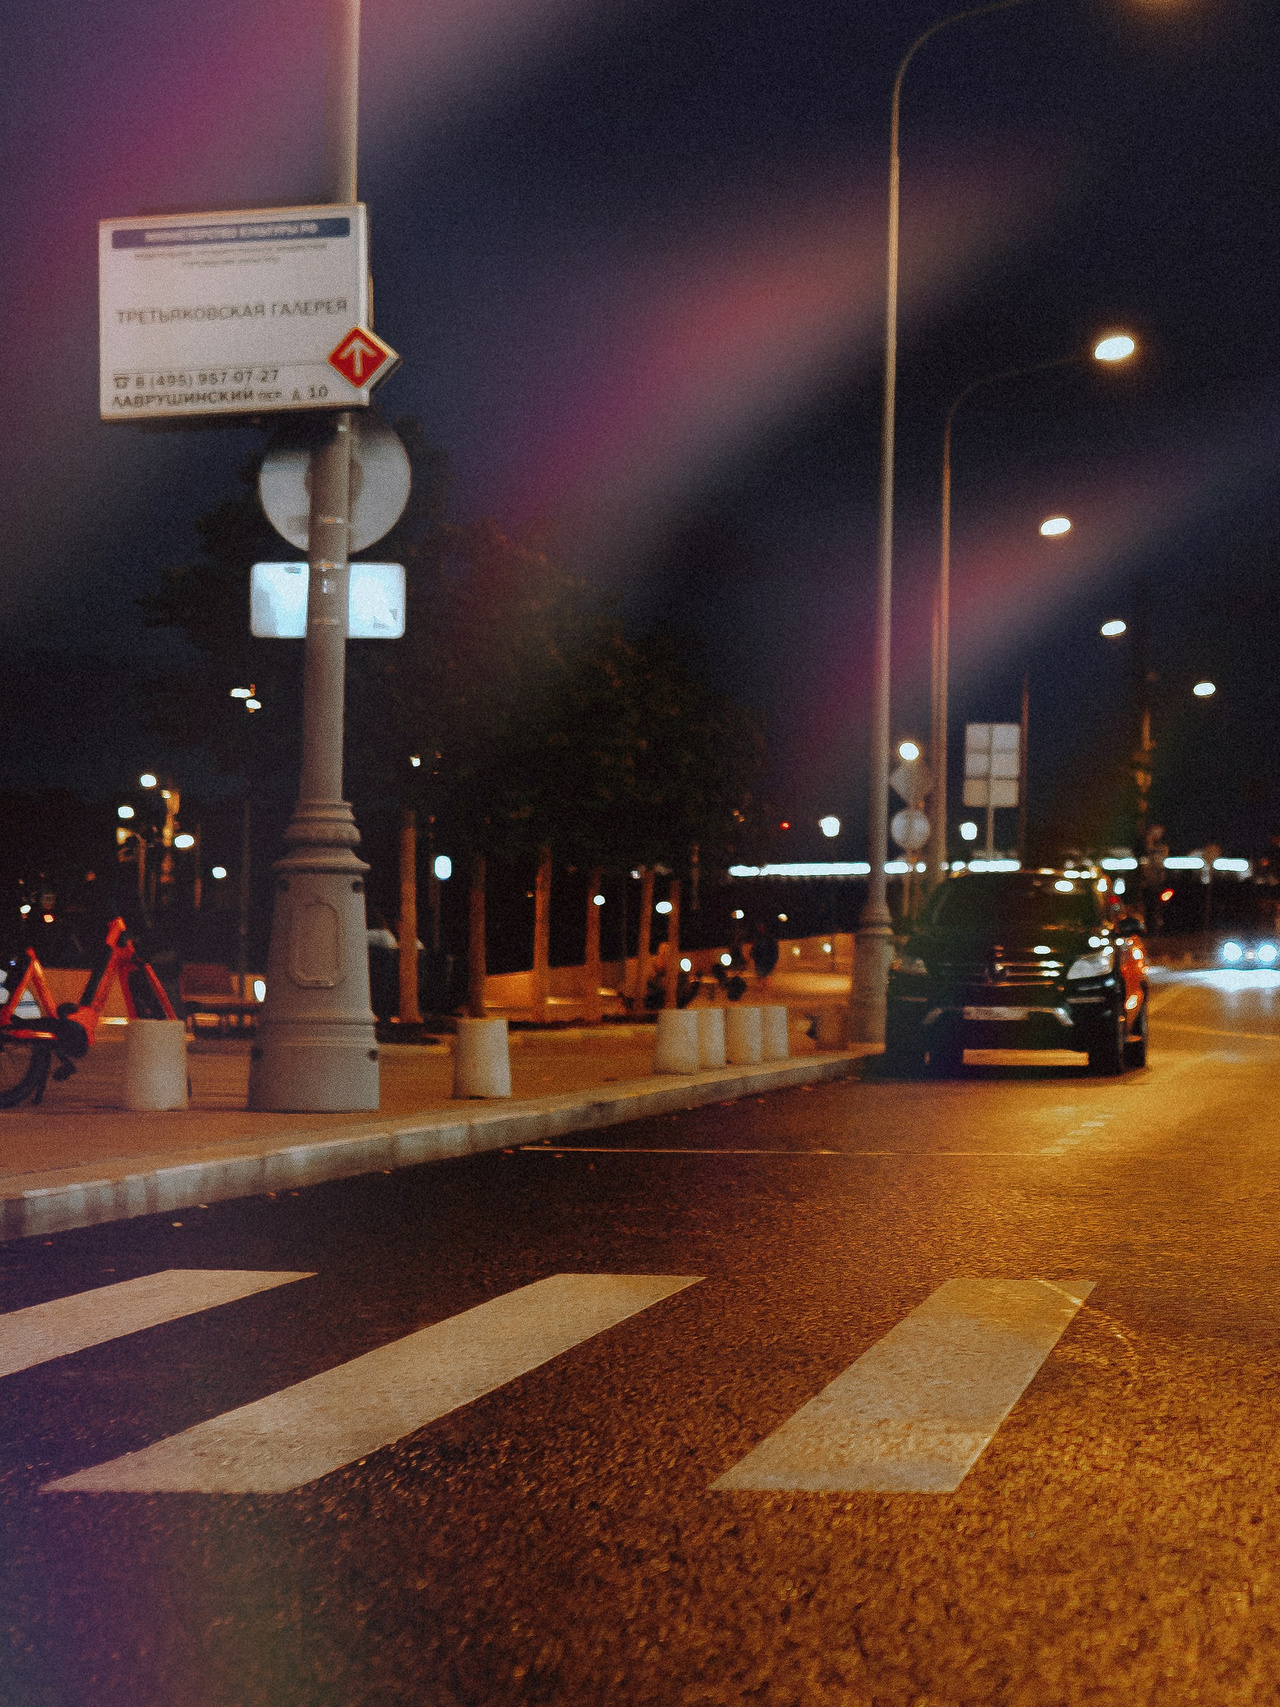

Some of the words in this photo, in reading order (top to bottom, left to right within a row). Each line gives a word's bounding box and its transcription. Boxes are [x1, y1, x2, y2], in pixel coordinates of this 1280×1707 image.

[117, 303, 265, 324] ТРЕТЬЯКОВСКАЯ
[270, 299, 348, 317] ГАЛЕРЕЯ
[149, 373, 193, 390] (495)
[112, 388, 254, 408] ЛАВРУШИНСКИЙ
[309, 384, 330, 400] 10
